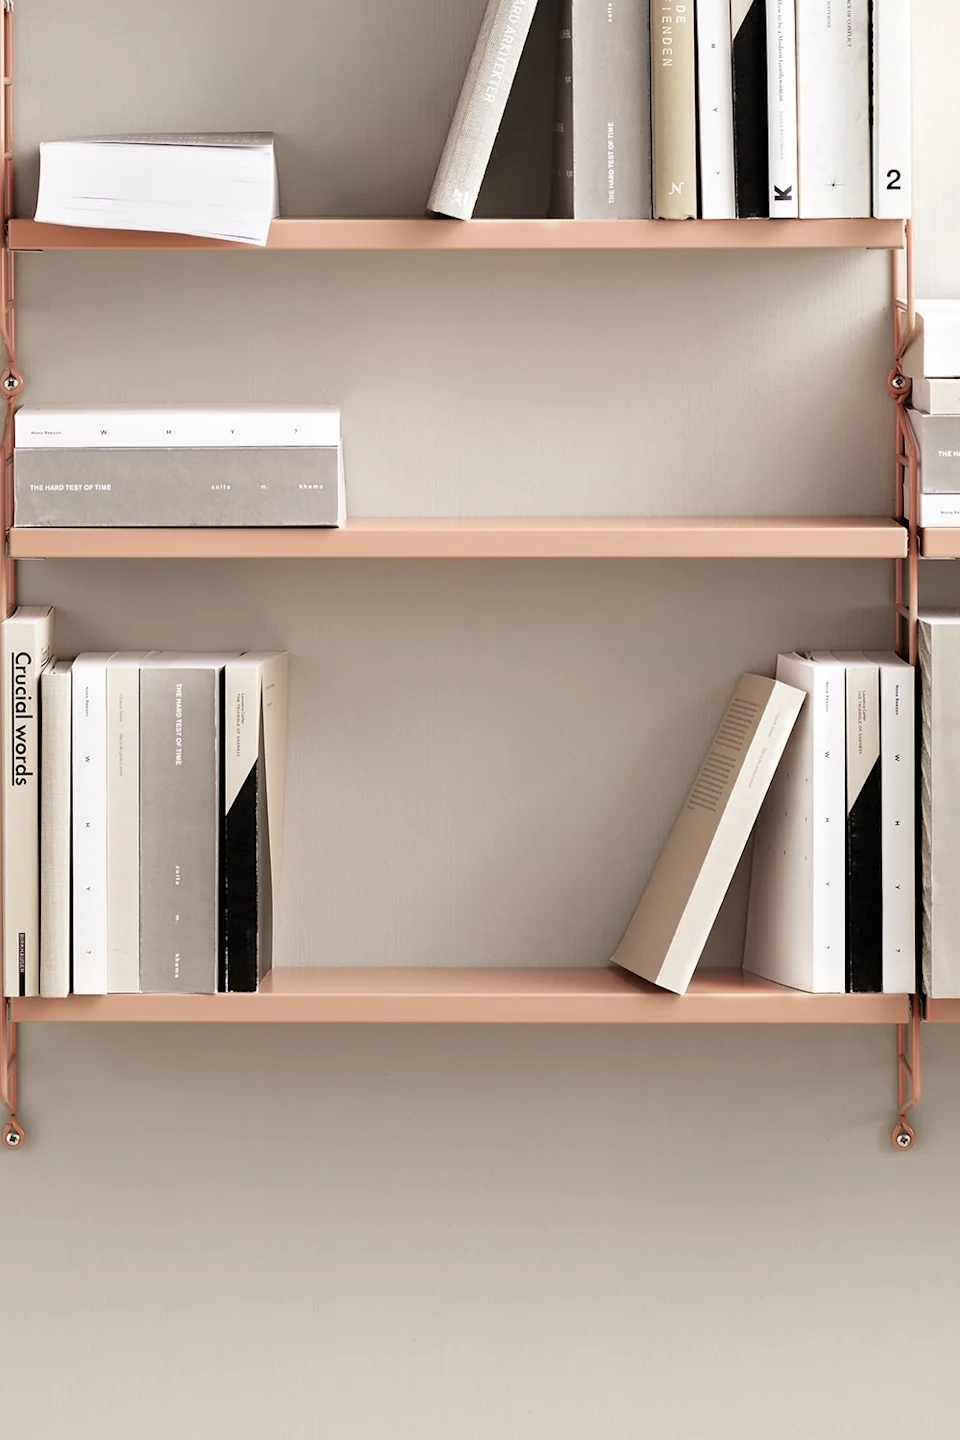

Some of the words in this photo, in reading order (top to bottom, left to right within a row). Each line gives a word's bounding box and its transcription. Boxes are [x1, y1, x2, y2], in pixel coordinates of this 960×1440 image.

[484, 27, 514, 103] ARKITEKTER
[608, 140, 614, 150] OF
[886, 169, 901, 190] 2
[774, 185, 792, 201] K
[15, 652, 33, 719] Crucial
[176, 737, 182, 747] OF
[15, 725, 33, 786] words
